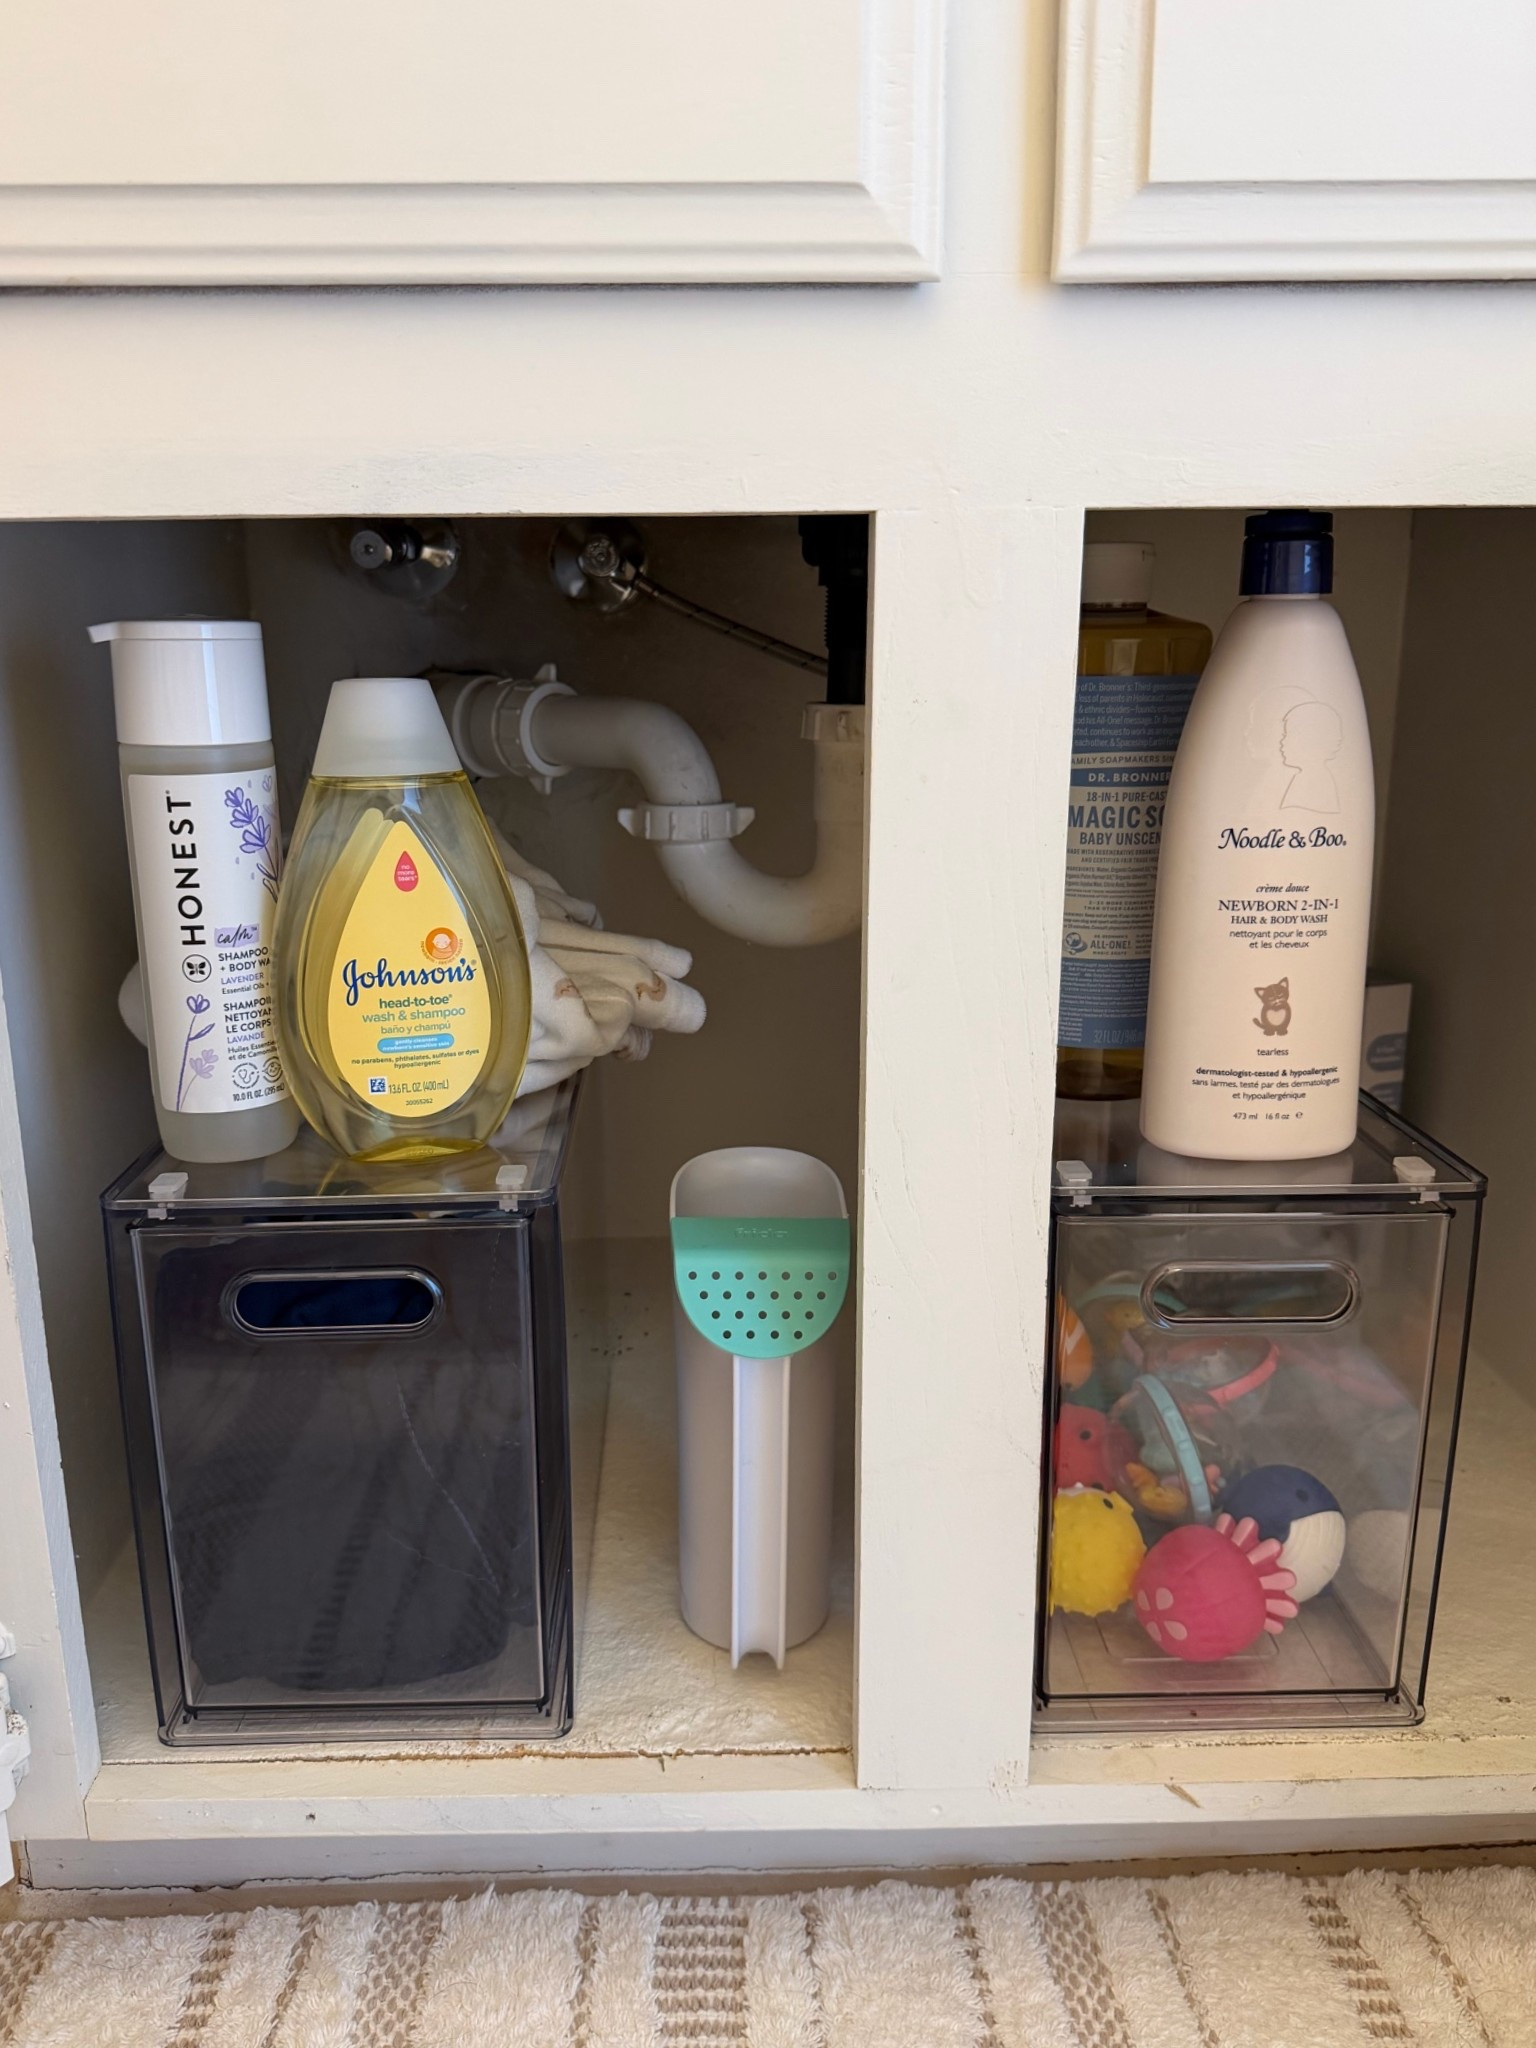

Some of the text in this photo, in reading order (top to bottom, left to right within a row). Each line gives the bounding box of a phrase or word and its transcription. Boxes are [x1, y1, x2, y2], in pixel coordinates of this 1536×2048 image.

[1071, 756, 1097, 765] AMILY
[1099, 755, 1160, 765] SOAPMAKERS
[1088, 773, 1110, 783] DR.
[1086, 791, 1119, 802] 18-IN-1
[1068, 805, 1141, 829] MAGIC
[1079, 832, 1161, 845] BABY UNSCEN
[1218, 827, 1285, 849] Noodle
[1288, 830, 1306, 849] &
[166, 795, 206, 946] HONEST
[1256, 883, 1310, 893] crème douce
[1218, 898, 1338, 912] NEWBORN 2-IN-1
[1231, 915, 1257, 924] HAIR
[1270, 915, 1299, 924] BODY
[1301, 914, 1328, 923] WASH
[217, 923, 253, 948] calm
[1230, 929, 1327, 939] nettoyant pour le corps
[1249, 940, 1309, 949] et les cheveux
[218, 946, 269, 962] SHAMPOO
[229, 960, 257, 972] BODY
[220, 972, 264, 985] LAVENDER
[343, 957, 476, 1007] Johnson's
[379, 995, 449, 1009] head-to-toe
[362, 1007, 466, 1023] wash & shampoo
[226, 1018, 272, 1034] LE CORPS
[380, 1020, 451, 1035] baño y champú
[227, 1031, 265, 1044] LAVANDE
[1257, 1048, 1289, 1056] tearless
[1196, 1066, 1338, 1078] dermatologist-tested & hypoallergenic
[1192, 1078, 1208, 1087] sans
[1240, 1080, 1259, 1089] testé
[1261, 1081, 1273, 1090] par
[1276, 1079, 1289, 1088] des
[1232, 1091, 1306, 1102] et hypoallergénique
[1233, 1112, 1247, 1120] 473
[1248, 1112, 1258, 1120] ml
